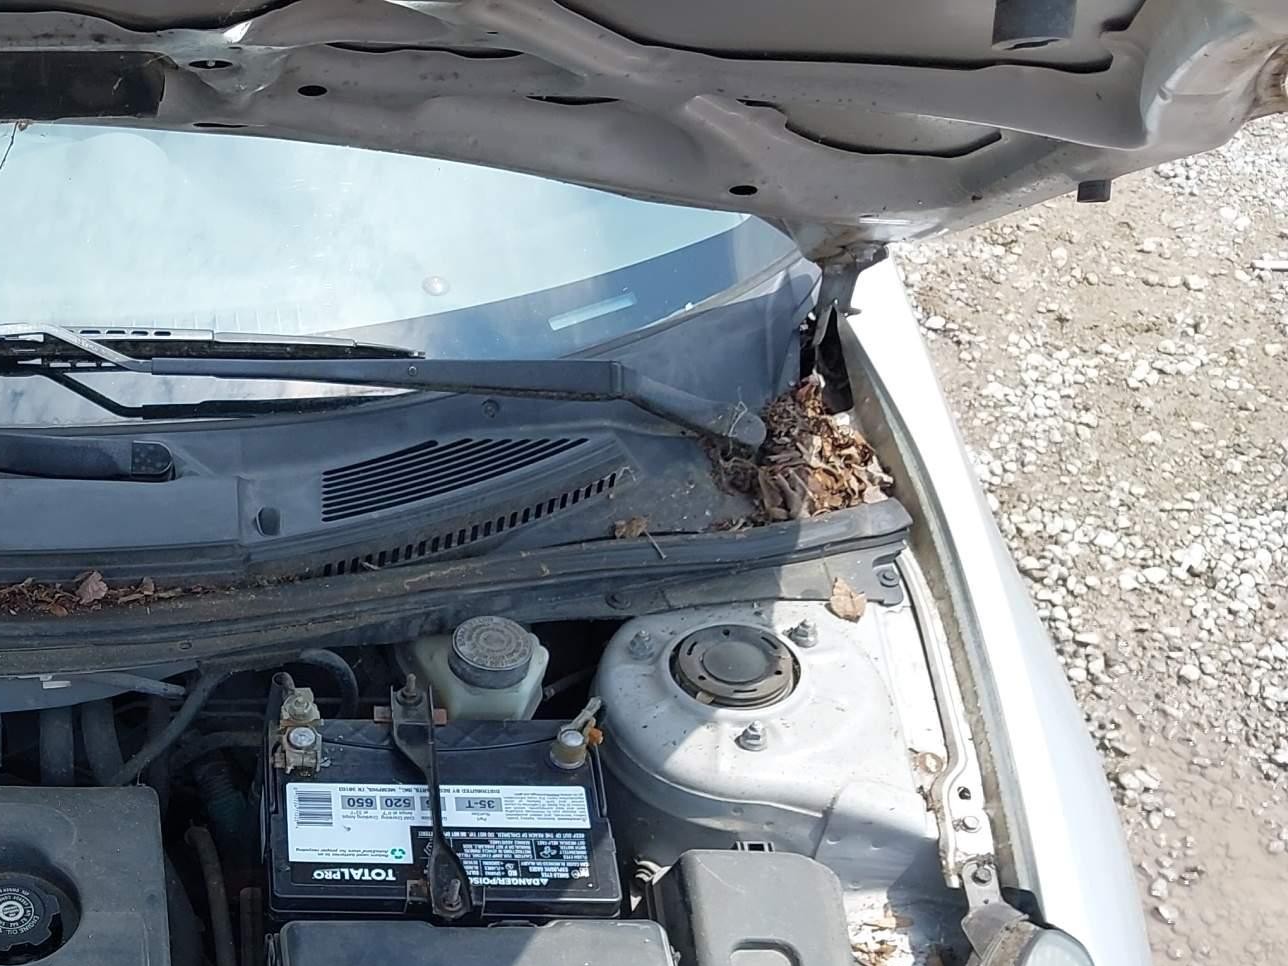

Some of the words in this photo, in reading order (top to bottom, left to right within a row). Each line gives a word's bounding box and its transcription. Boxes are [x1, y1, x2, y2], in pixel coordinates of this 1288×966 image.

[347, 798, 373, 807] 650
[385, 798, 411, 807] 520
[466, 800, 495, 809] 35-T
[313, 868, 396, 880] TOTALPRO
[468, 876, 540, 886] DANGER/POIS
[18, 915, 39, 933] ENGINE
